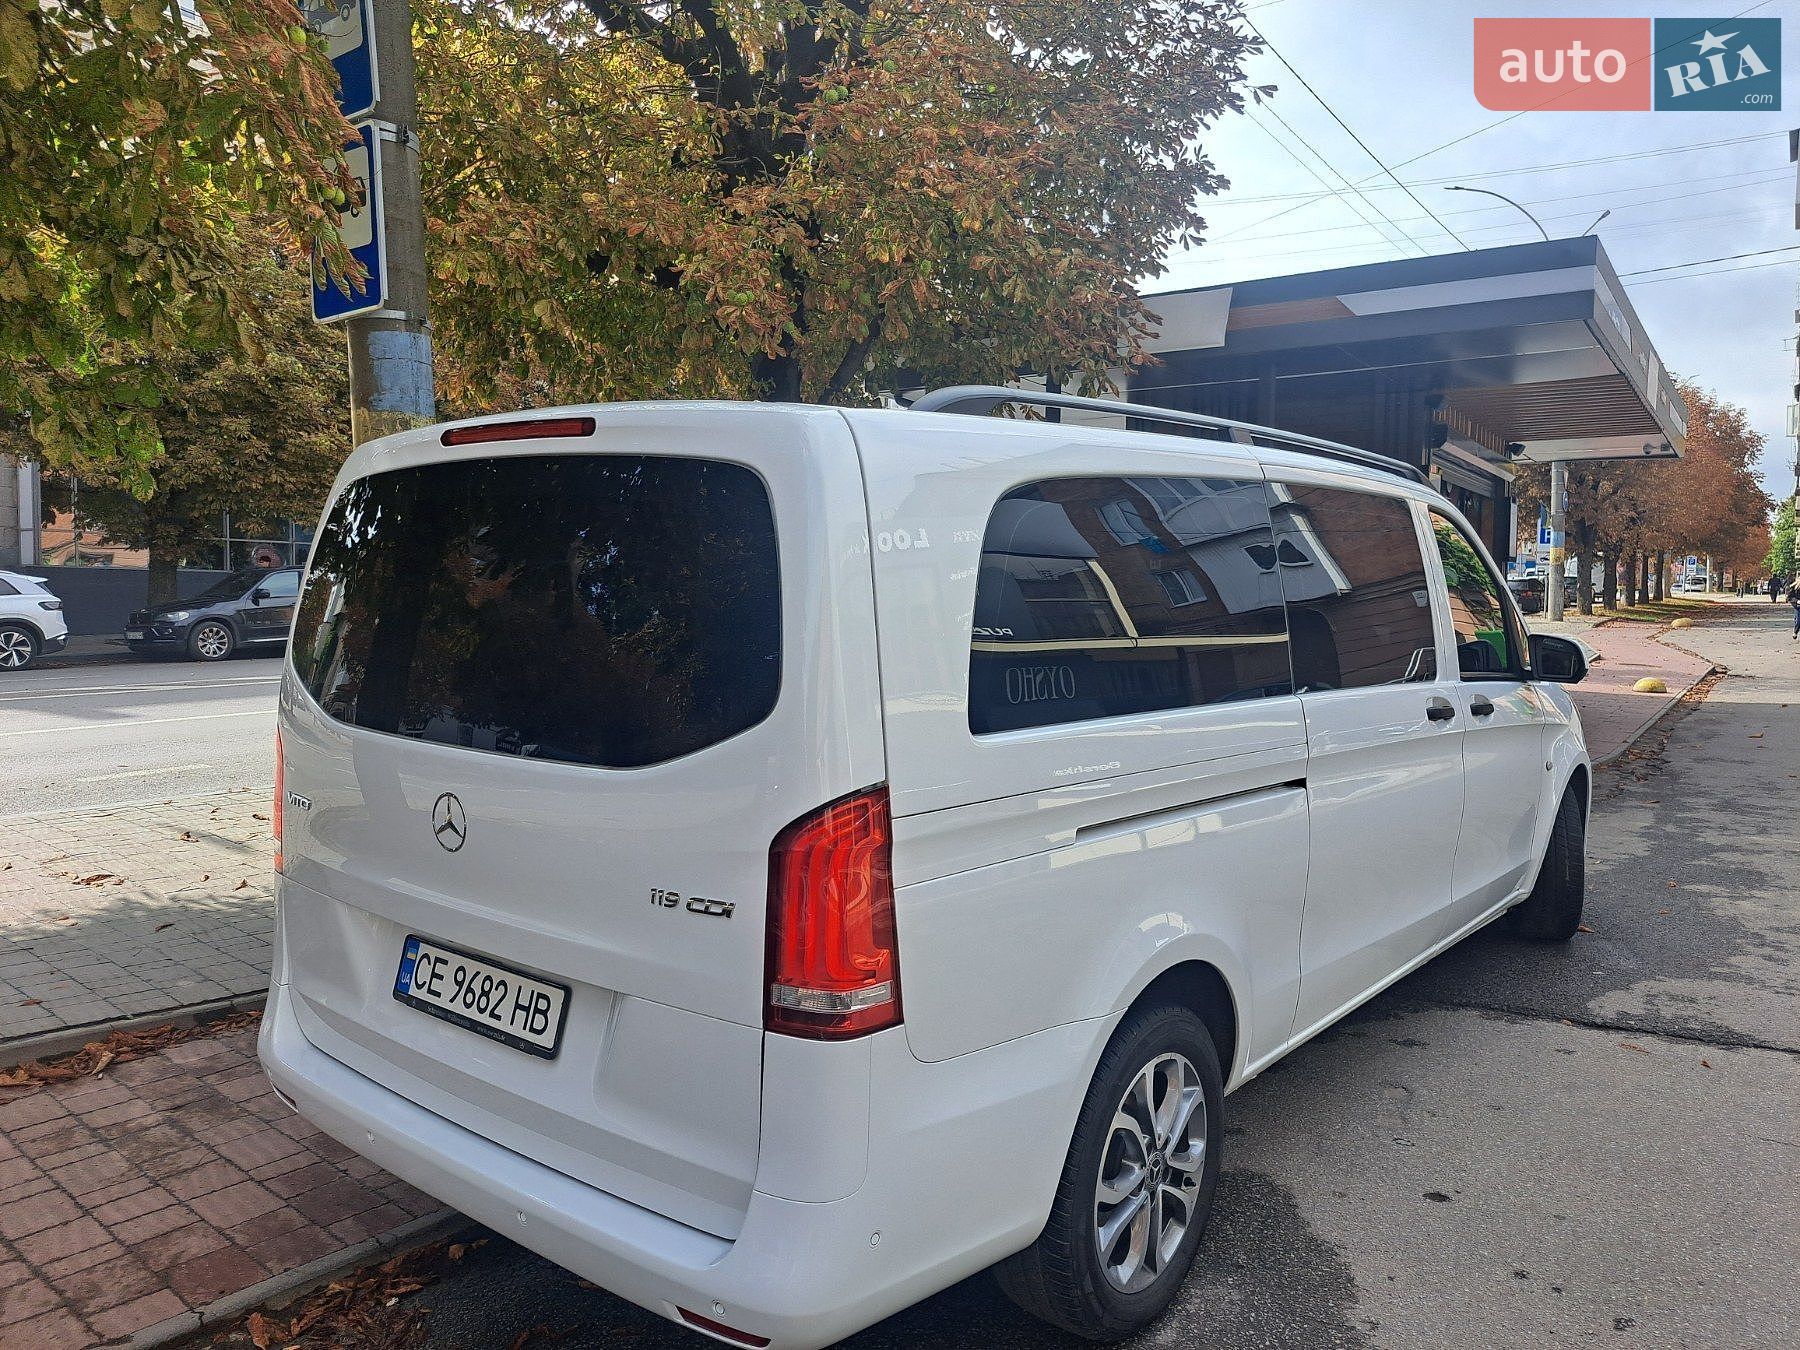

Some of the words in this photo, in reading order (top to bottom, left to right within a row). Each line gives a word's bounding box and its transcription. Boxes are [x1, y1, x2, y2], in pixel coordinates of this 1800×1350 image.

[650, 888, 680, 908] 119
[414, 953, 449, 998] CE
[449, 965, 509, 1021] 9682
[509, 985, 551, 1036] HB
